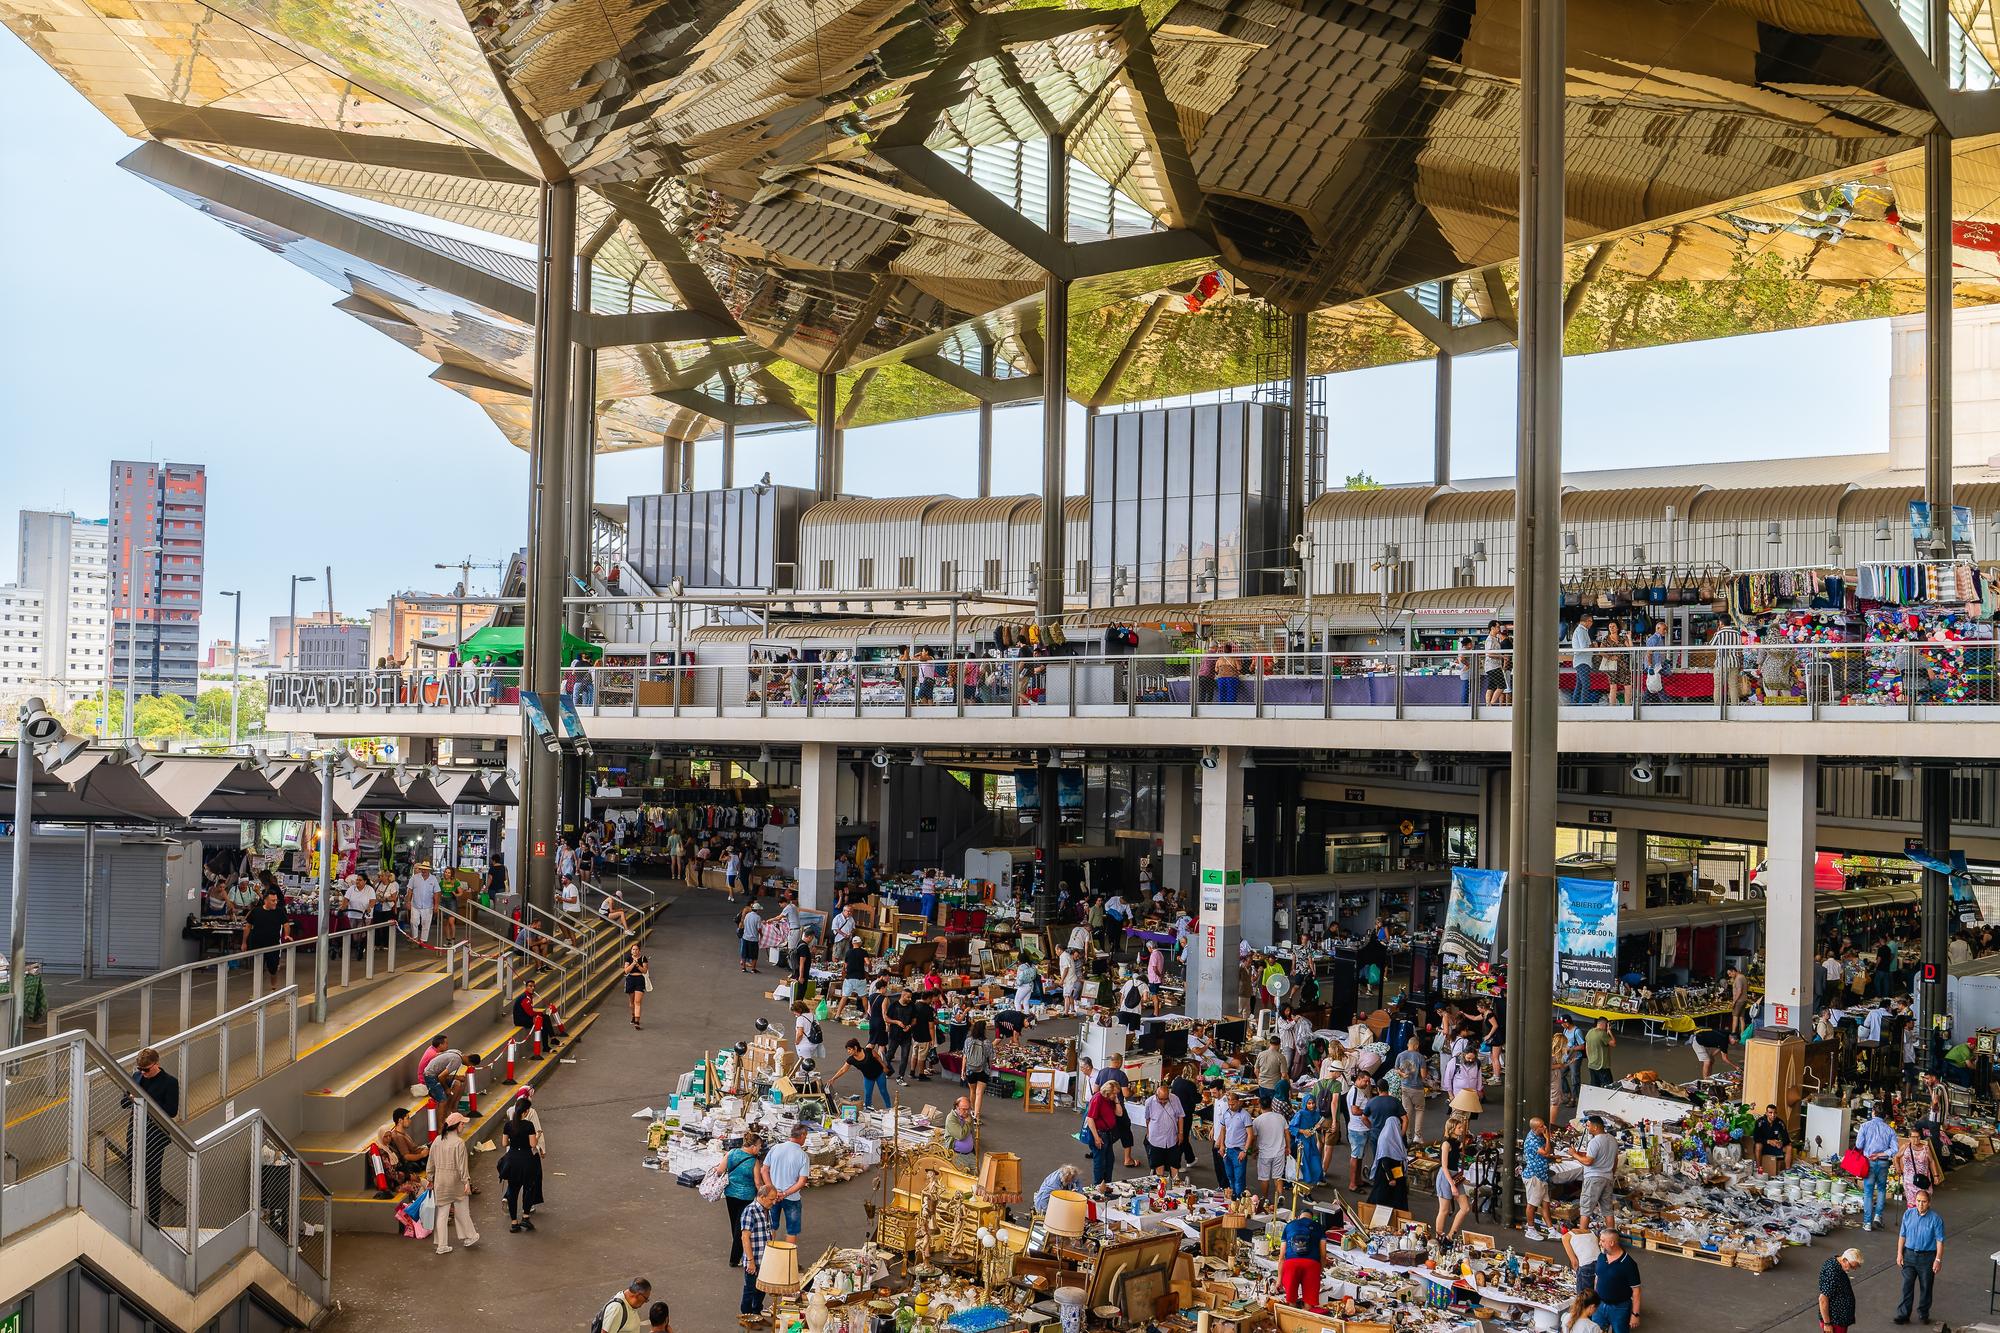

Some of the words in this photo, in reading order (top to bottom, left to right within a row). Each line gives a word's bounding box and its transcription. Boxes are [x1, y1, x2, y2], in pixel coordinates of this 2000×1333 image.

[271, 674, 319, 707] FIRA
[326, 674, 357, 707] DE
[362, 673, 494, 708] BELLCAIRE
[1571, 901, 1603, 909] ABIERTO
[1566, 927, 1580, 935] 9:00
[1587, 929, 1607, 937] 20:00
[1580, 966, 1611, 974] BARCELONA
[1924, 964, 1936, 979] D
